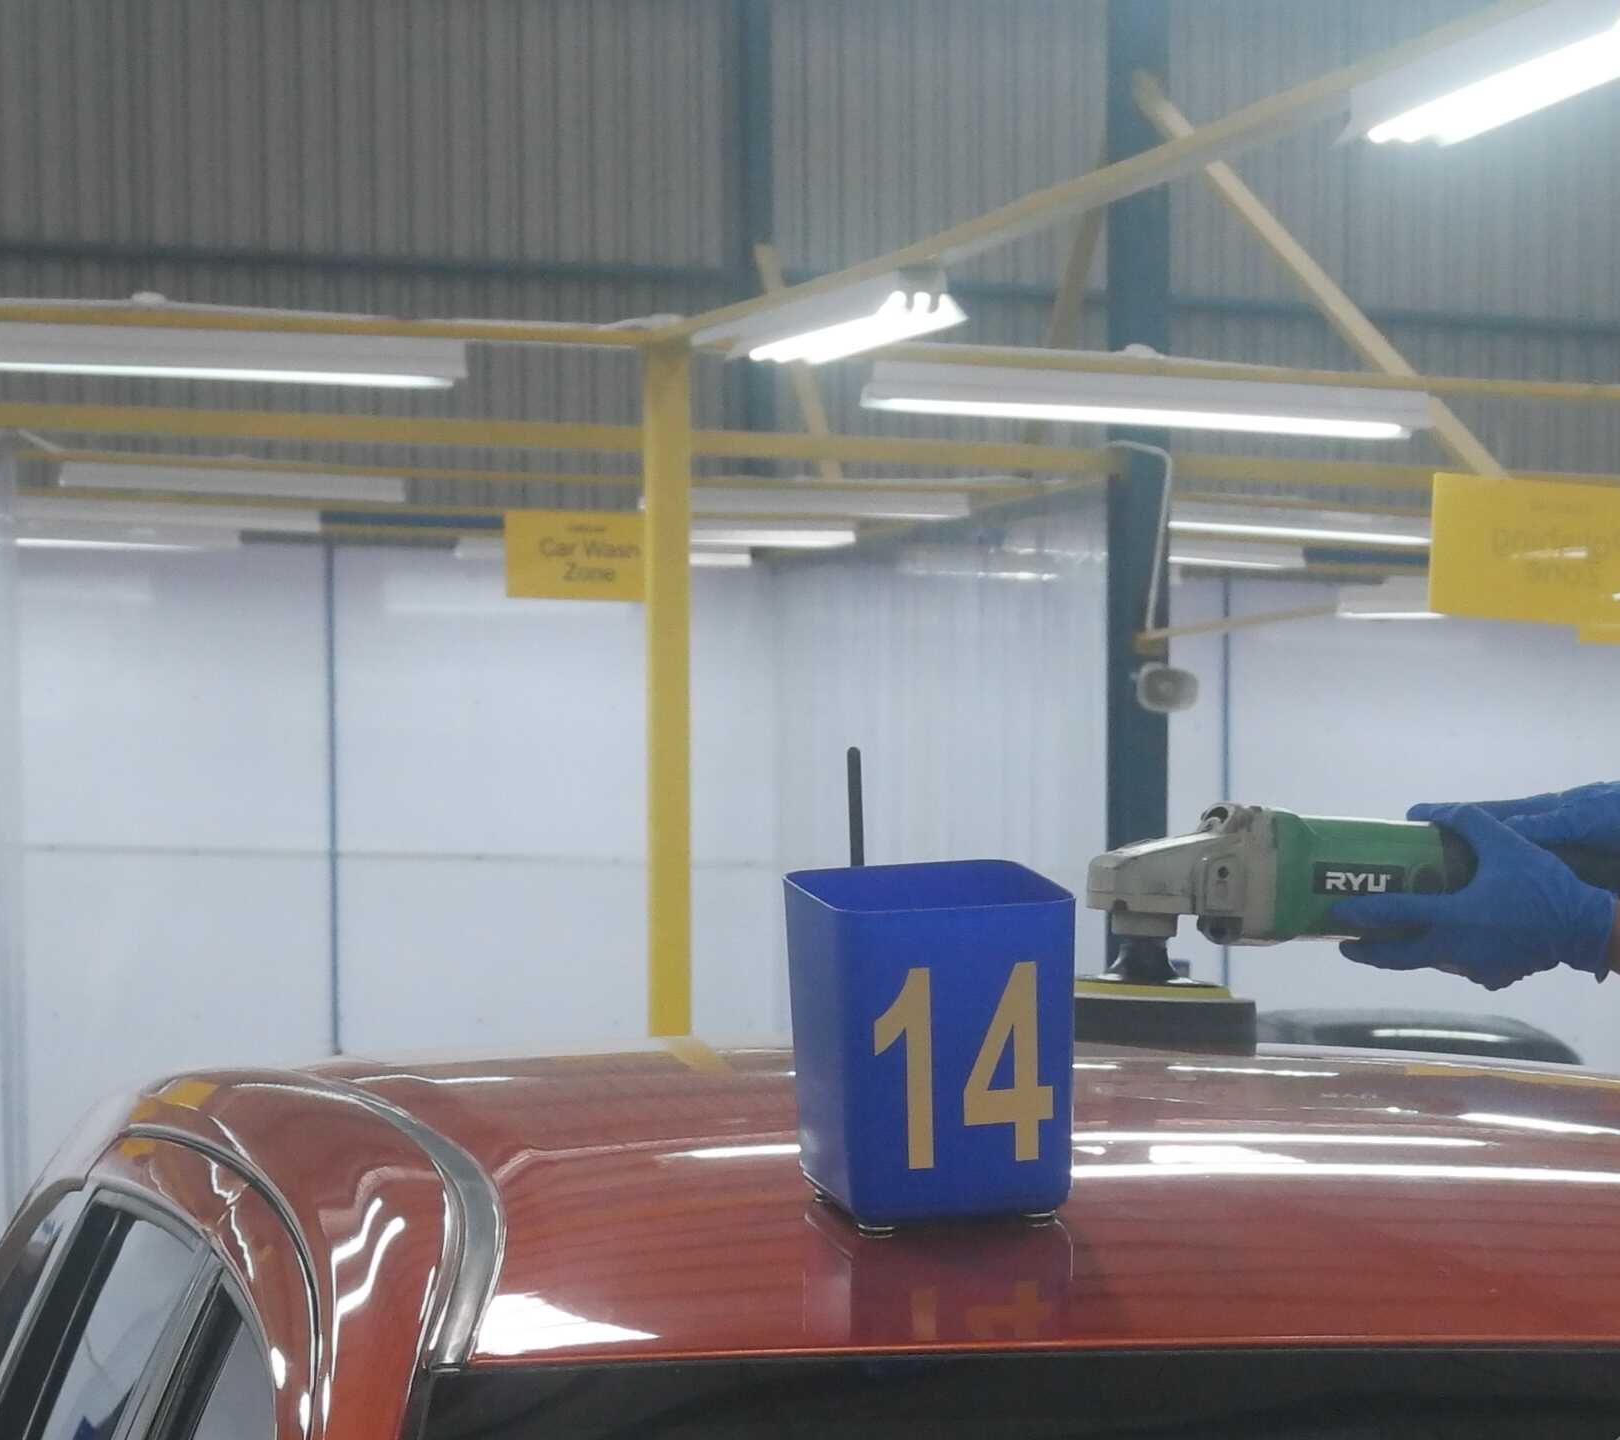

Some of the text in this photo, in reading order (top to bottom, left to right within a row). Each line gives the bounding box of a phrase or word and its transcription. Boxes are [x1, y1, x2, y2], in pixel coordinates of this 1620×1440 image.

[539, 536, 642, 559] Car Wash
[563, 562, 617, 582] Zone
[1325, 871, 1388, 892] RYU
[874, 961, 1054, 1170] 14
